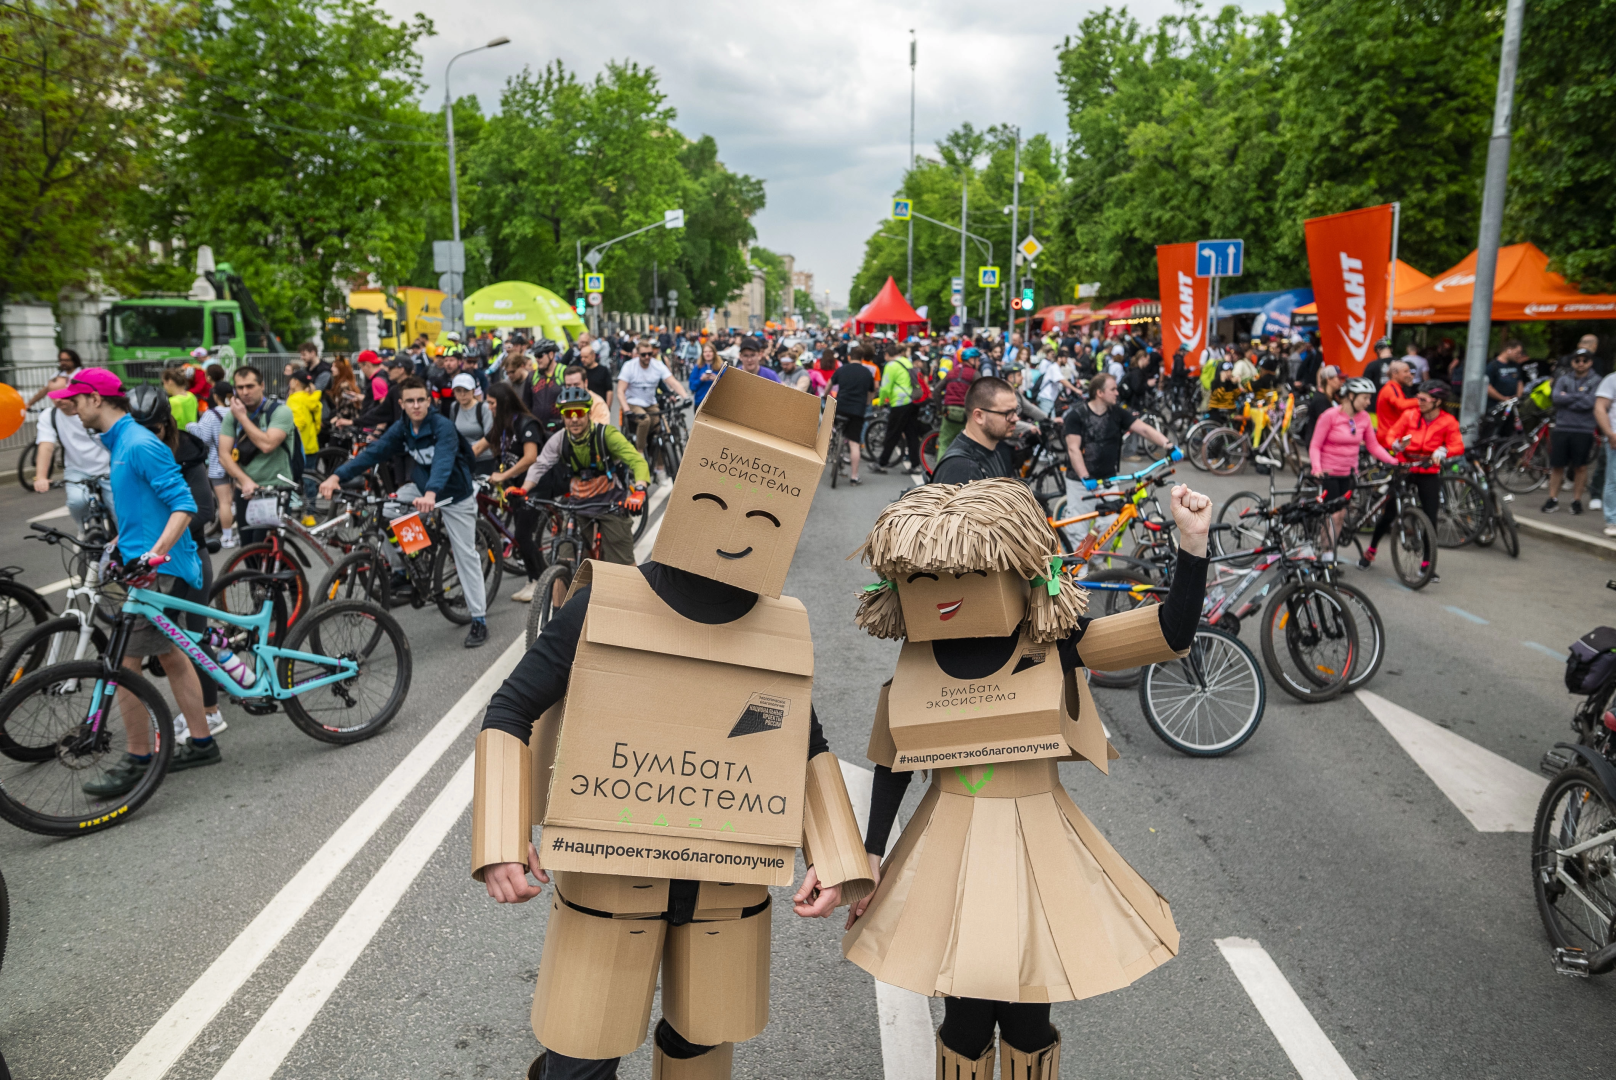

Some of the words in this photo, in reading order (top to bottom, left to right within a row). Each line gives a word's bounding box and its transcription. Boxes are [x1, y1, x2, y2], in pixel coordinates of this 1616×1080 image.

[1178, 270, 1194, 337] КАНТ
[1339, 251, 1366, 343] КАНТ
[699, 457, 802, 498] экосистема
[720, 447, 786, 480] БумБатл
[152, 615, 191, 648] SANTA
[188, 647, 219, 672] CRUZ
[926, 691, 1017, 709] экосистема
[940, 684, 1001, 698] БумБатл
[611, 742, 753, 784] БумБатл
[899, 741, 1060, 765] #нацпроектэкоблагополучие
[570, 773, 787, 815] экосистема
[79, 805, 128, 828] MAXXIS
[552, 837, 785, 870] #нацпроектэкоблагополучие
